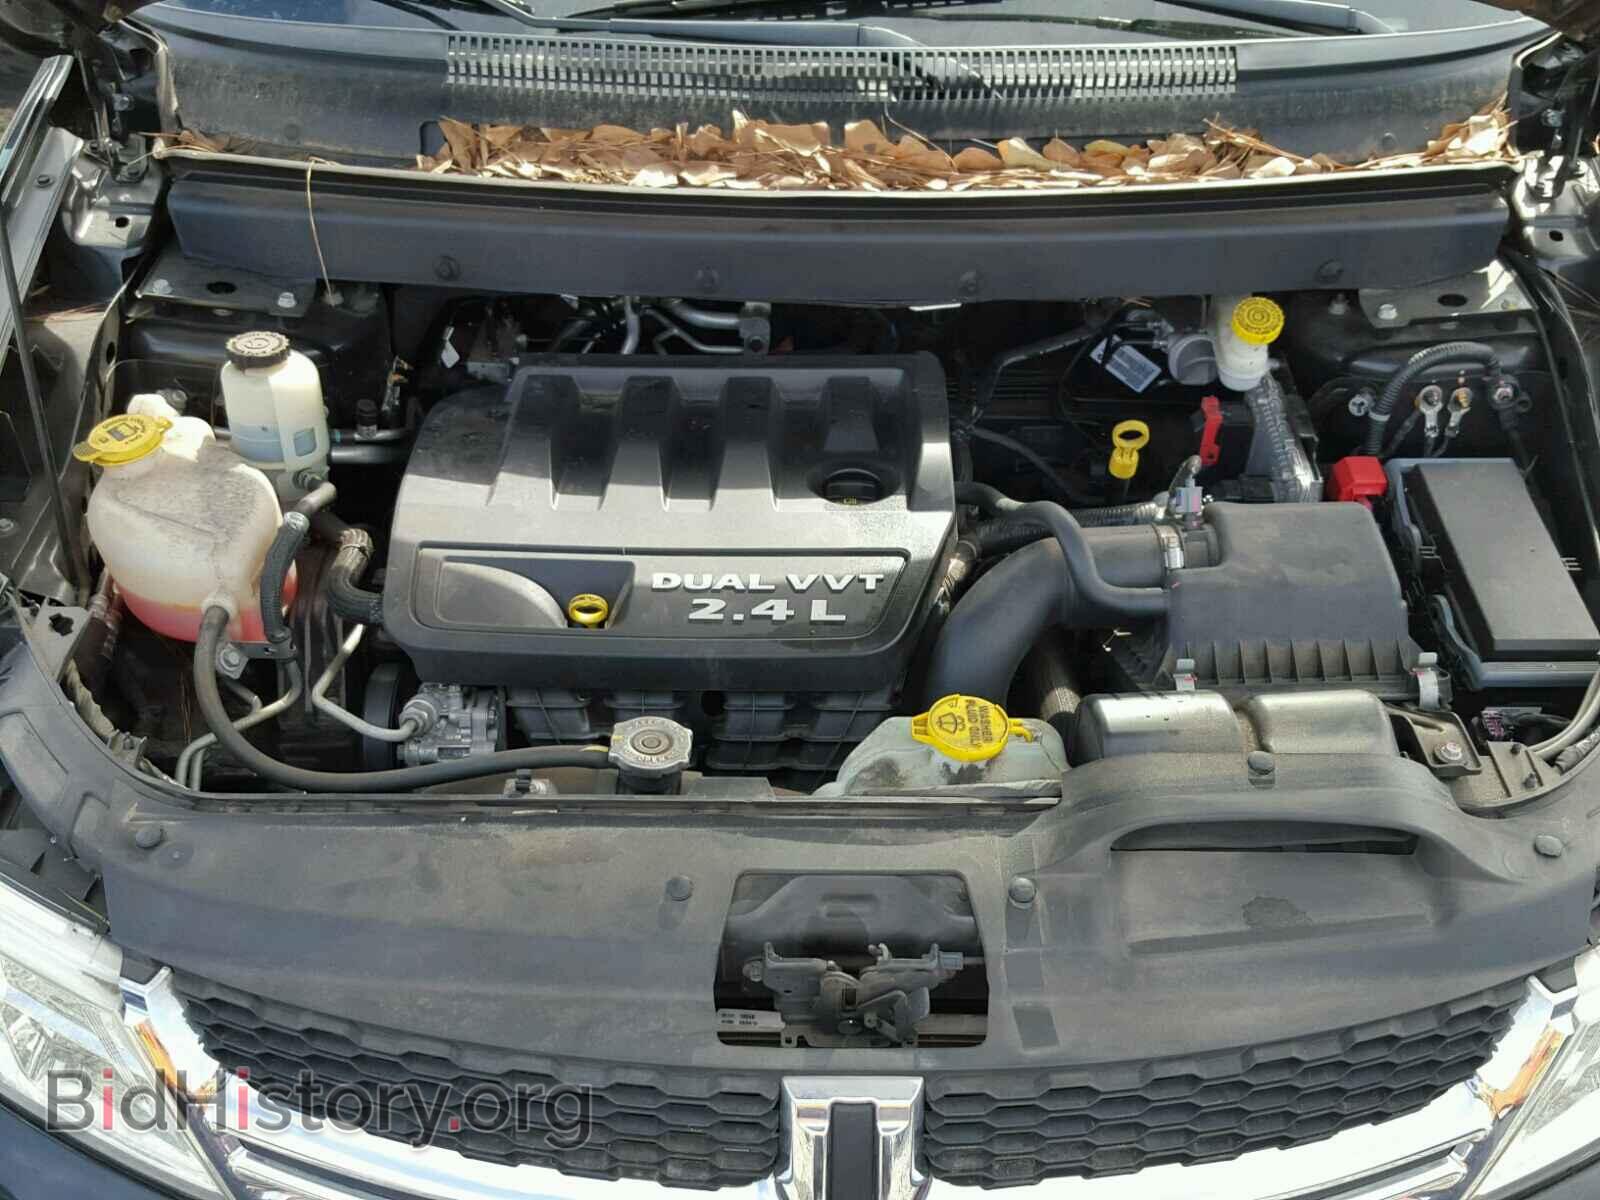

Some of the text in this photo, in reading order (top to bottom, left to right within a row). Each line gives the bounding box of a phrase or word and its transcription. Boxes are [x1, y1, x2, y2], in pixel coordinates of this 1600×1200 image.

[651, 572, 885, 593] DUAL VVT
[688, 598, 847, 622] 2.4 L
[979, 705, 993, 743] WASHER
